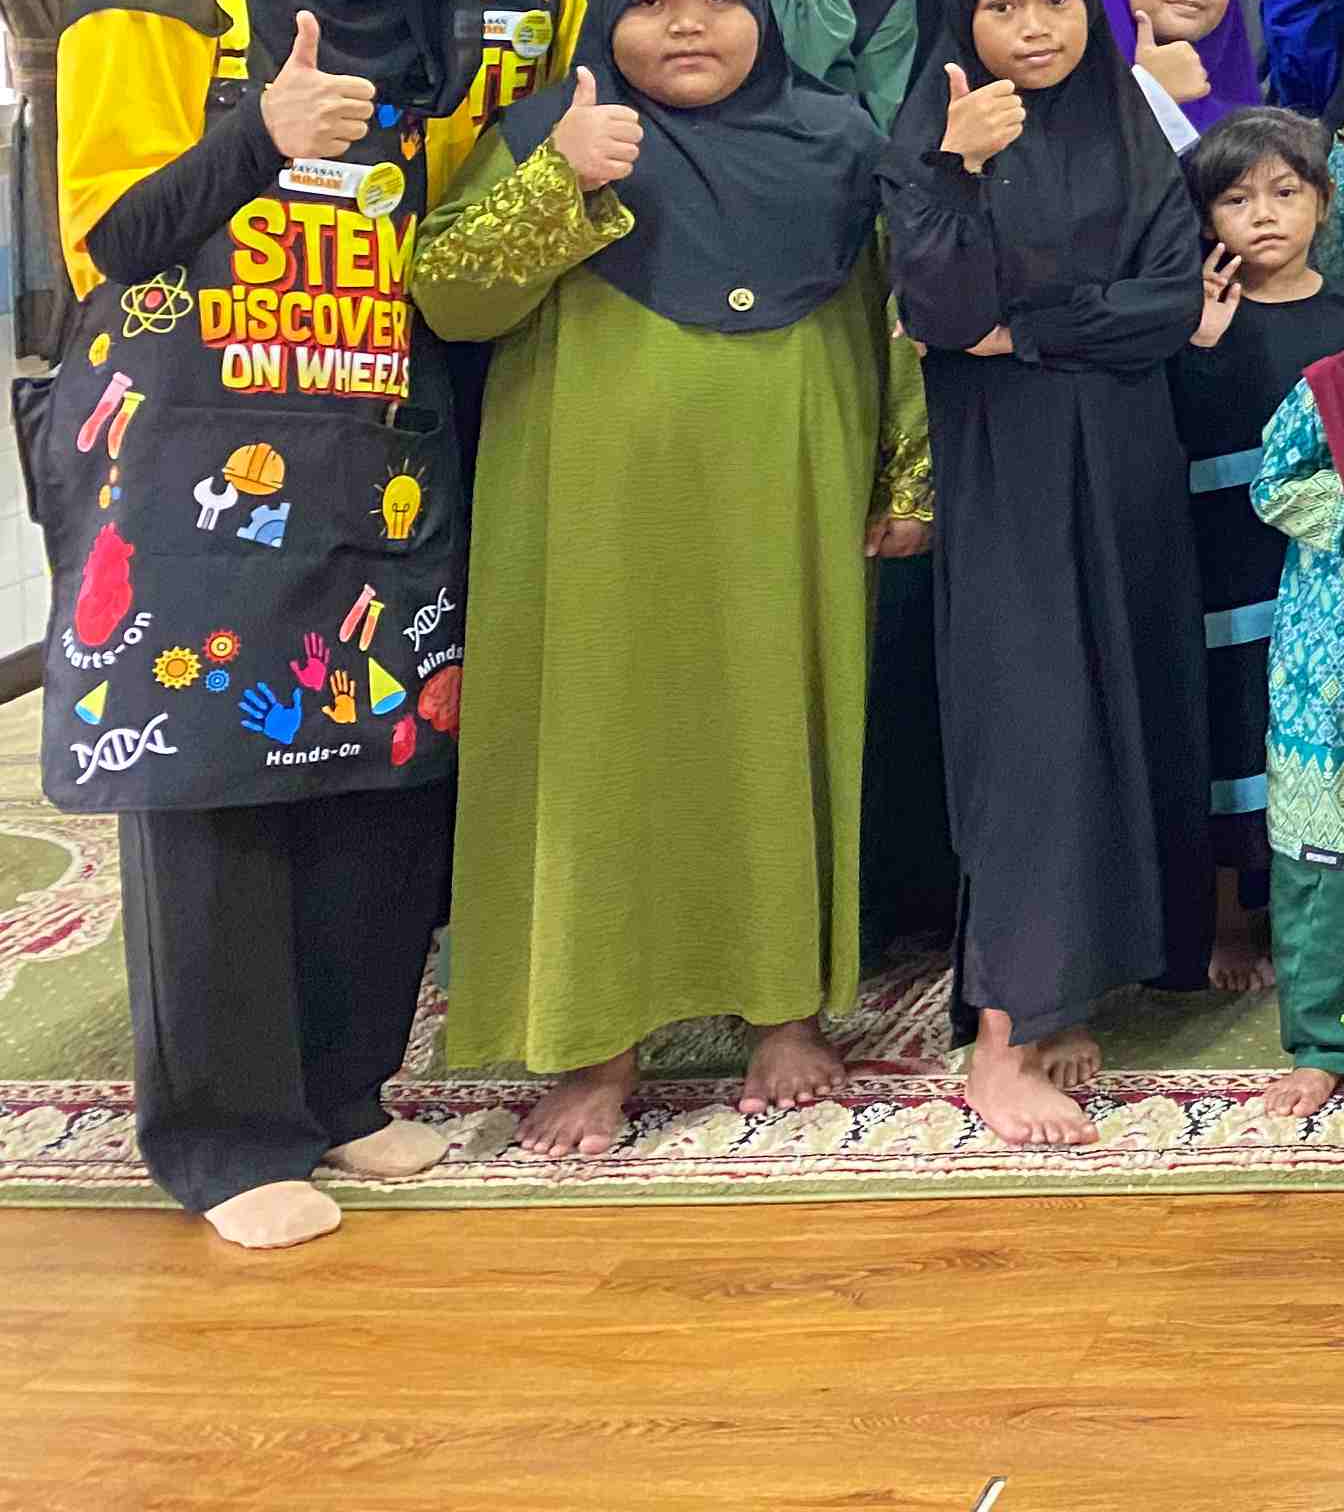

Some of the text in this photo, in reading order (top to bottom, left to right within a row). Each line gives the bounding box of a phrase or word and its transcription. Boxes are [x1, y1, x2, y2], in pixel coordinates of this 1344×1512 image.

[231, 198, 417, 294] STEM
[222, 343, 281, 388] ON
[265, 742, 361, 766] Hands-On
